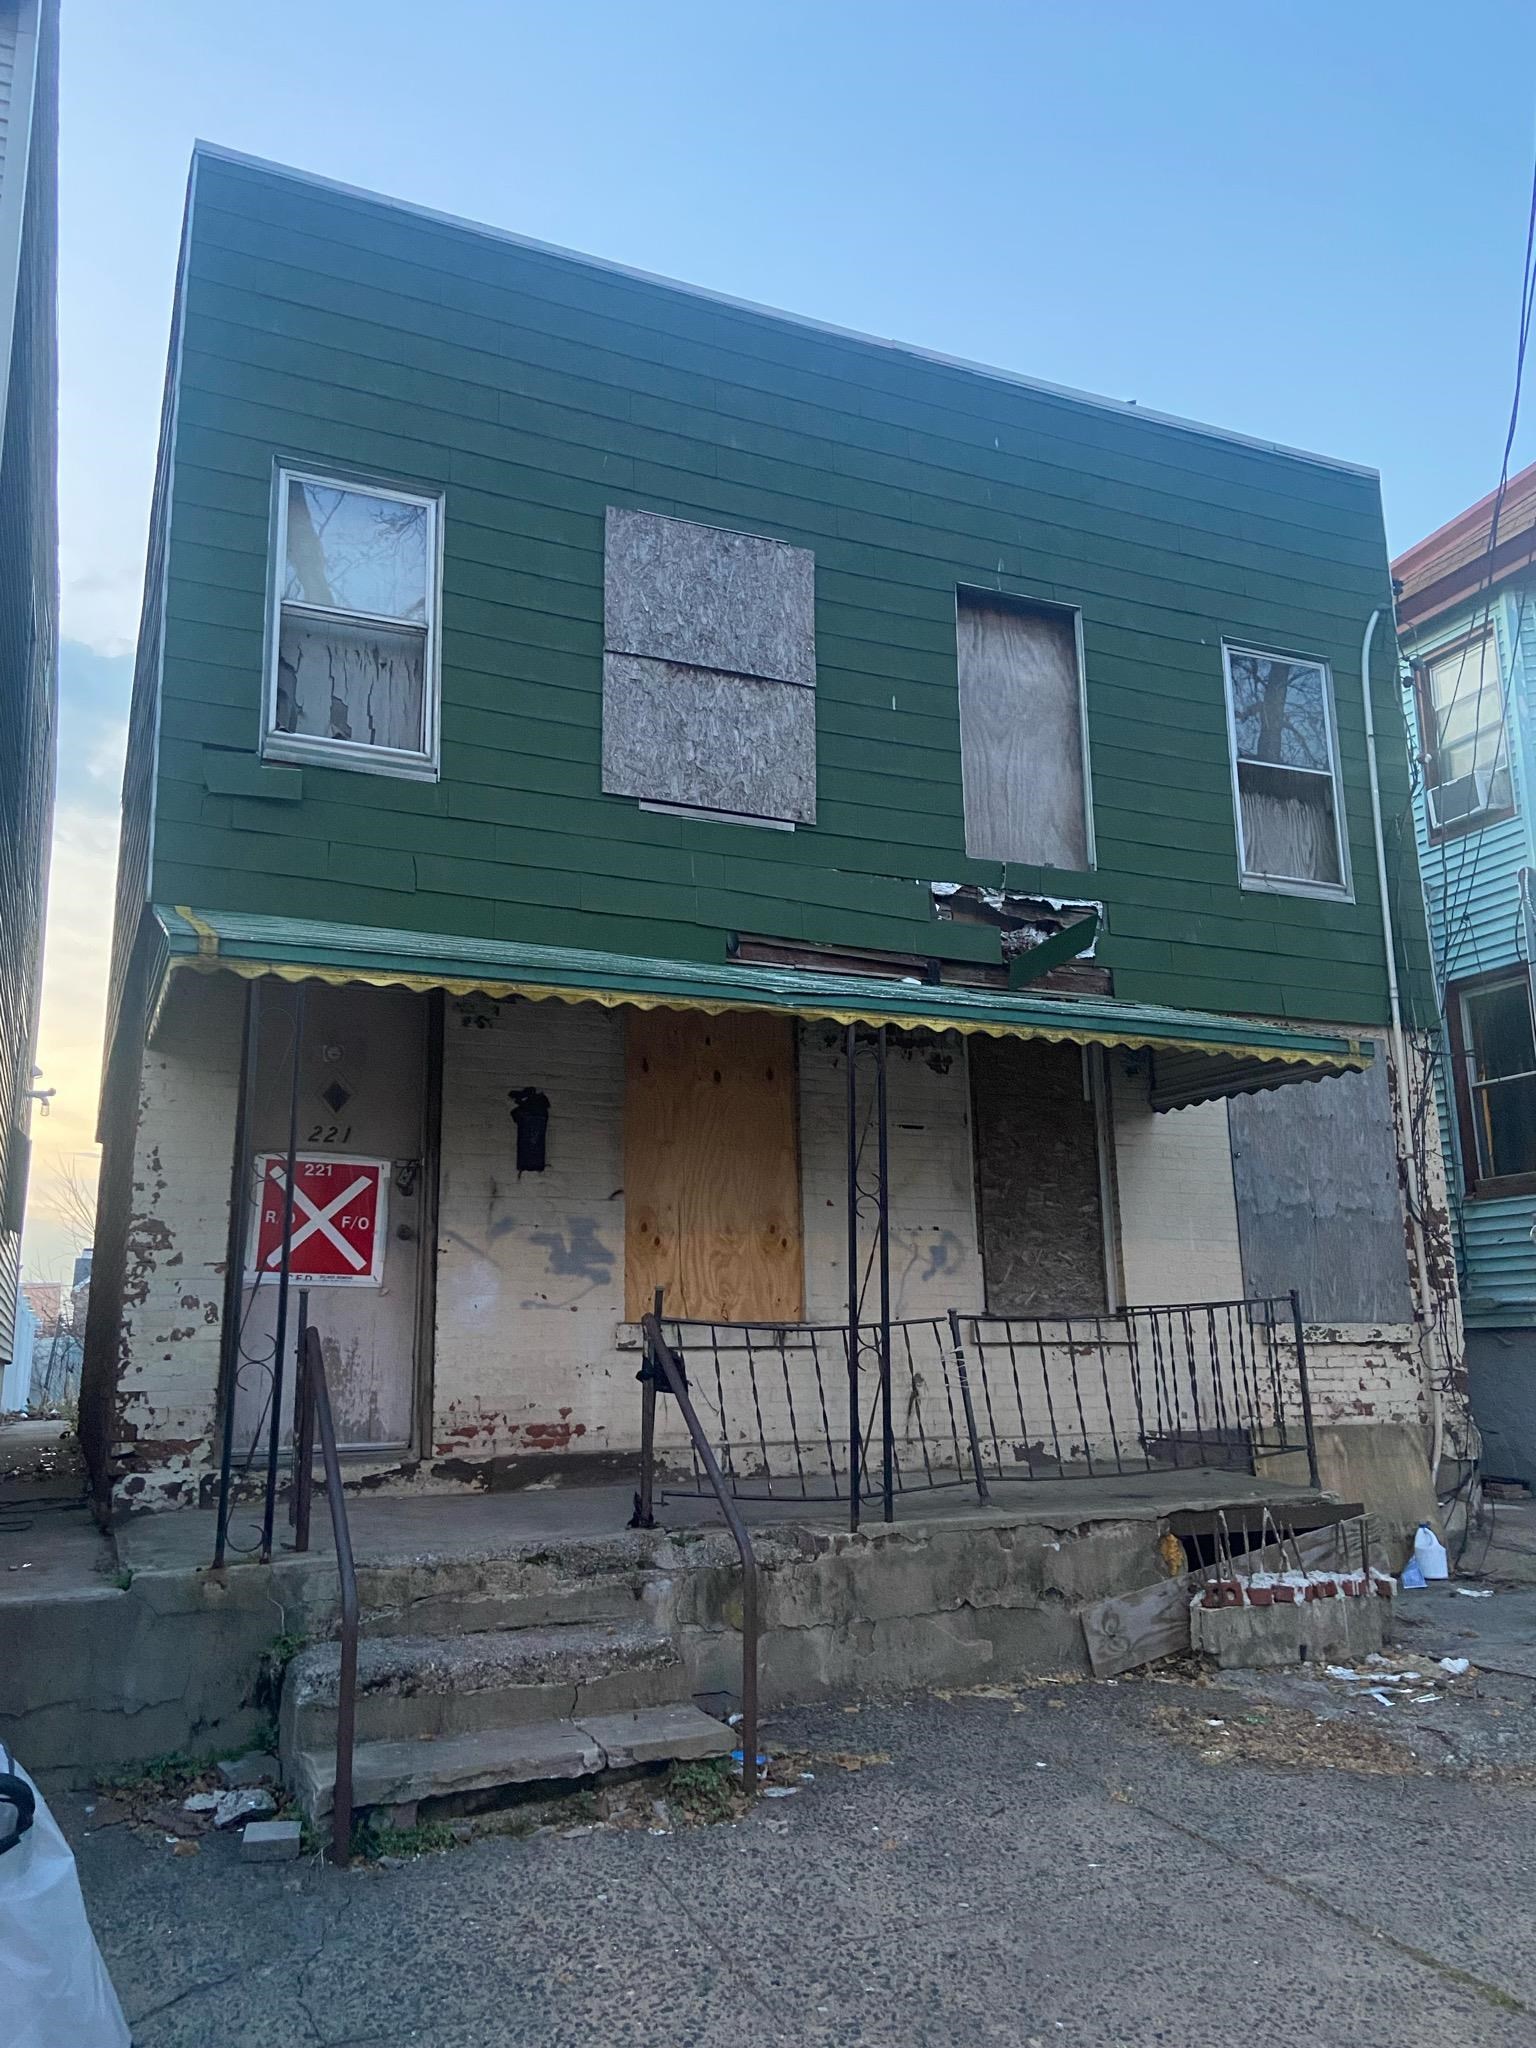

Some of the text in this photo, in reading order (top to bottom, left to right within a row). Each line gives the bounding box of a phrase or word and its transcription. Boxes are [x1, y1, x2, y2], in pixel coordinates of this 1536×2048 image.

[308, 1125, 351, 1144] 221
[304, 1163, 333, 1177] 221
[341, 1215, 370, 1230] F/O
